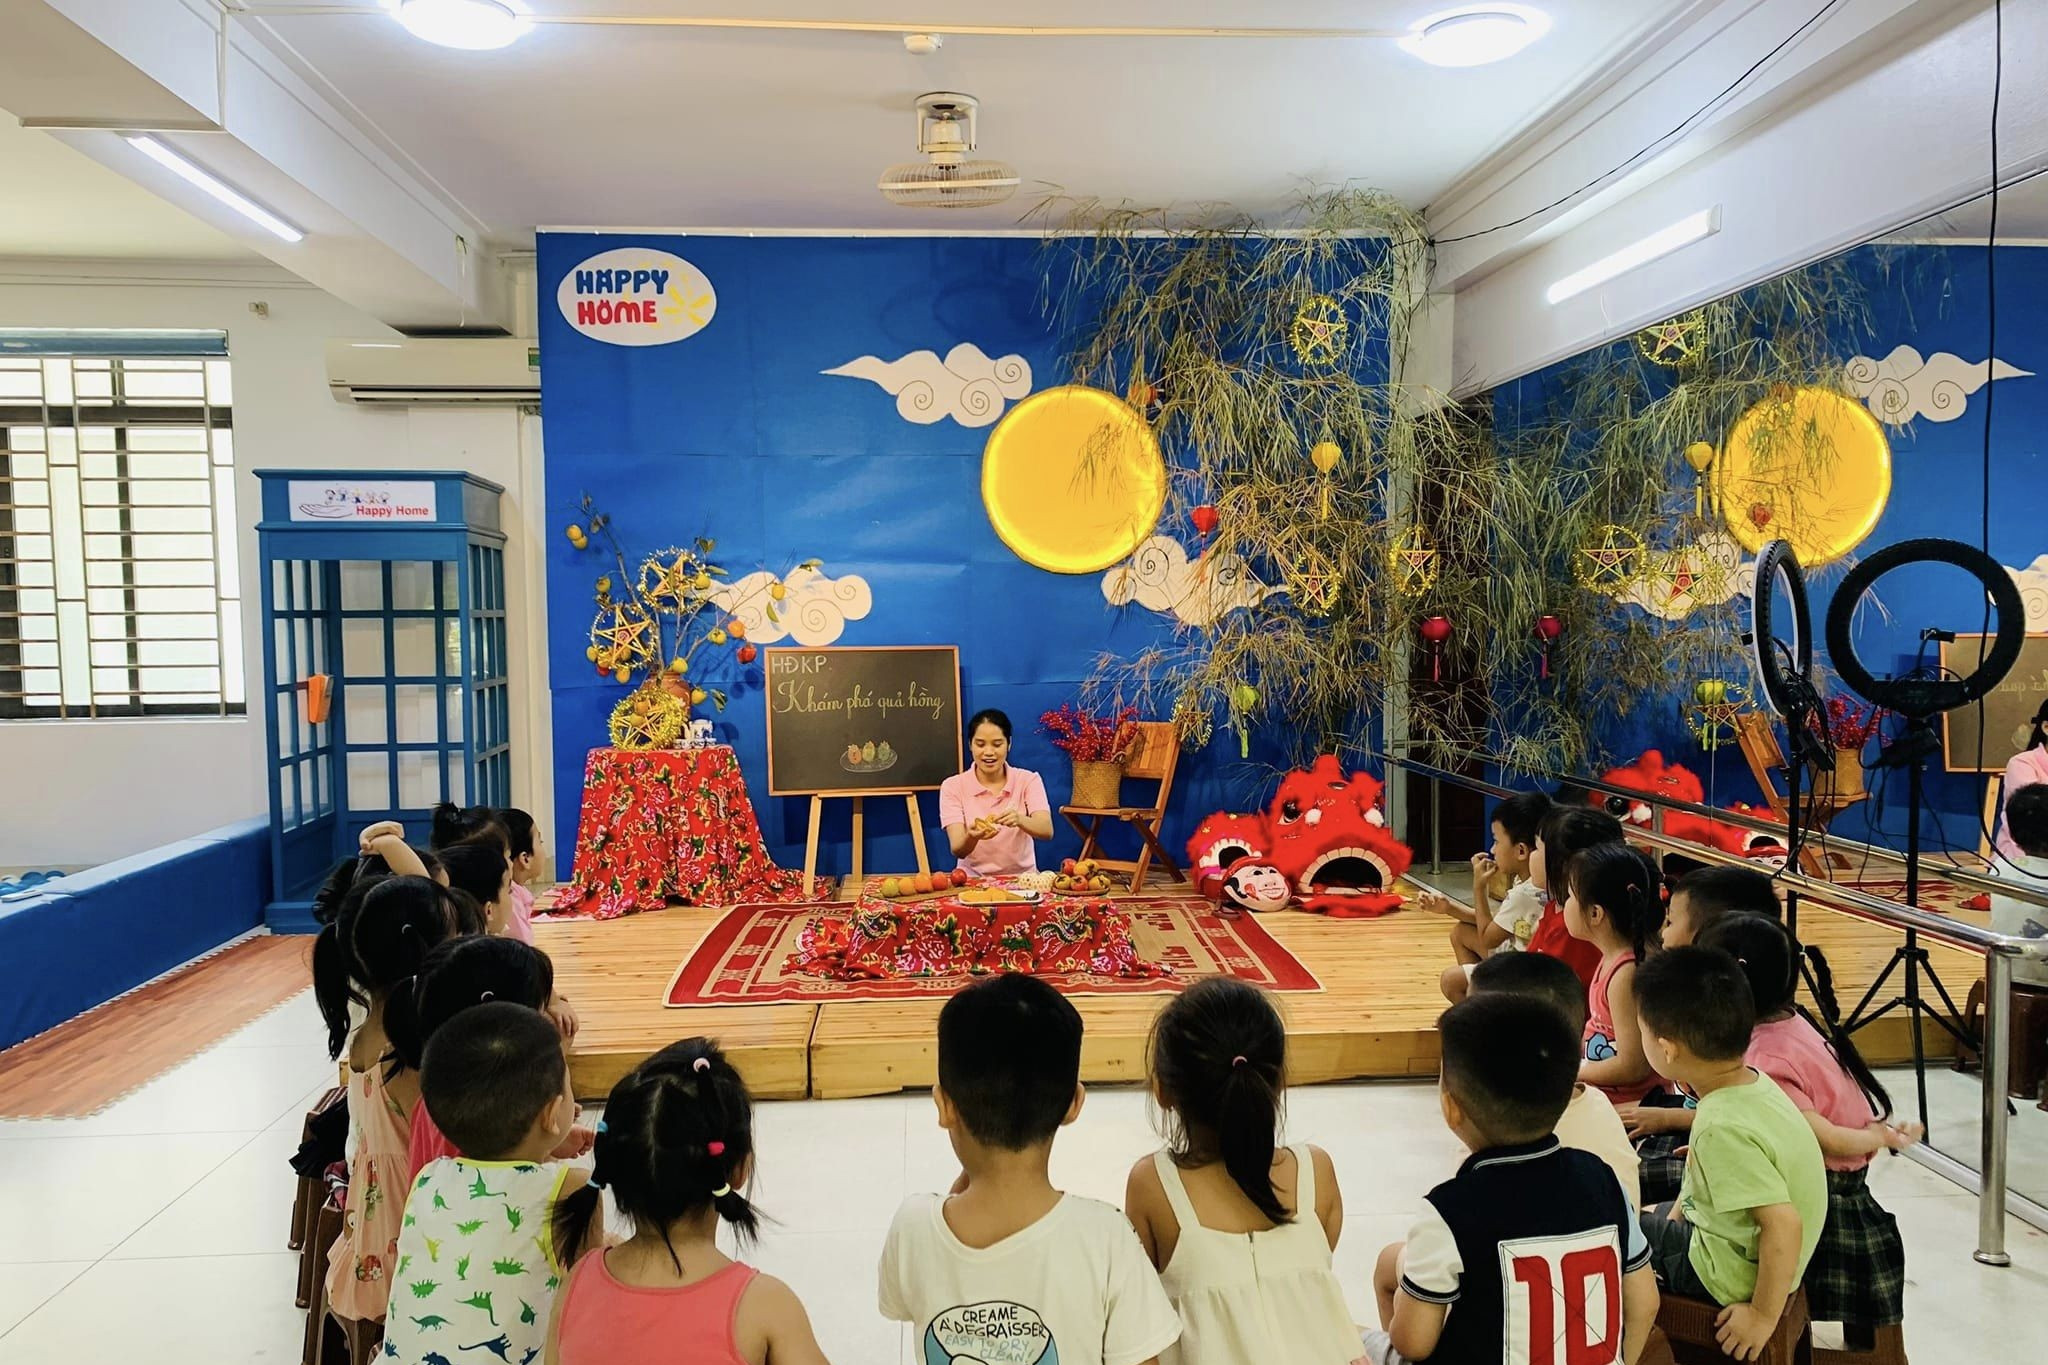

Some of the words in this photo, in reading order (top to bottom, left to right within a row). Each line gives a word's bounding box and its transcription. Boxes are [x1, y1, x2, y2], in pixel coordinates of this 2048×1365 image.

[575, 269, 669, 295] HAPPY
[577, 299, 658, 325] HOME
[356, 505, 392, 518] Happy
[396, 505, 429, 516] Home
[773, 680, 844, 714] Khám
[846, 684, 875, 720] phá
[877, 690, 906, 720] quả
[907, 681, 945, 720] hồng
[962, 1306, 1019, 1325] CREAME
[1512, 1245, 1621, 1365] 10
[944, 1334, 975, 1347] EASY
[999, 1337, 1030, 1351] DRY
